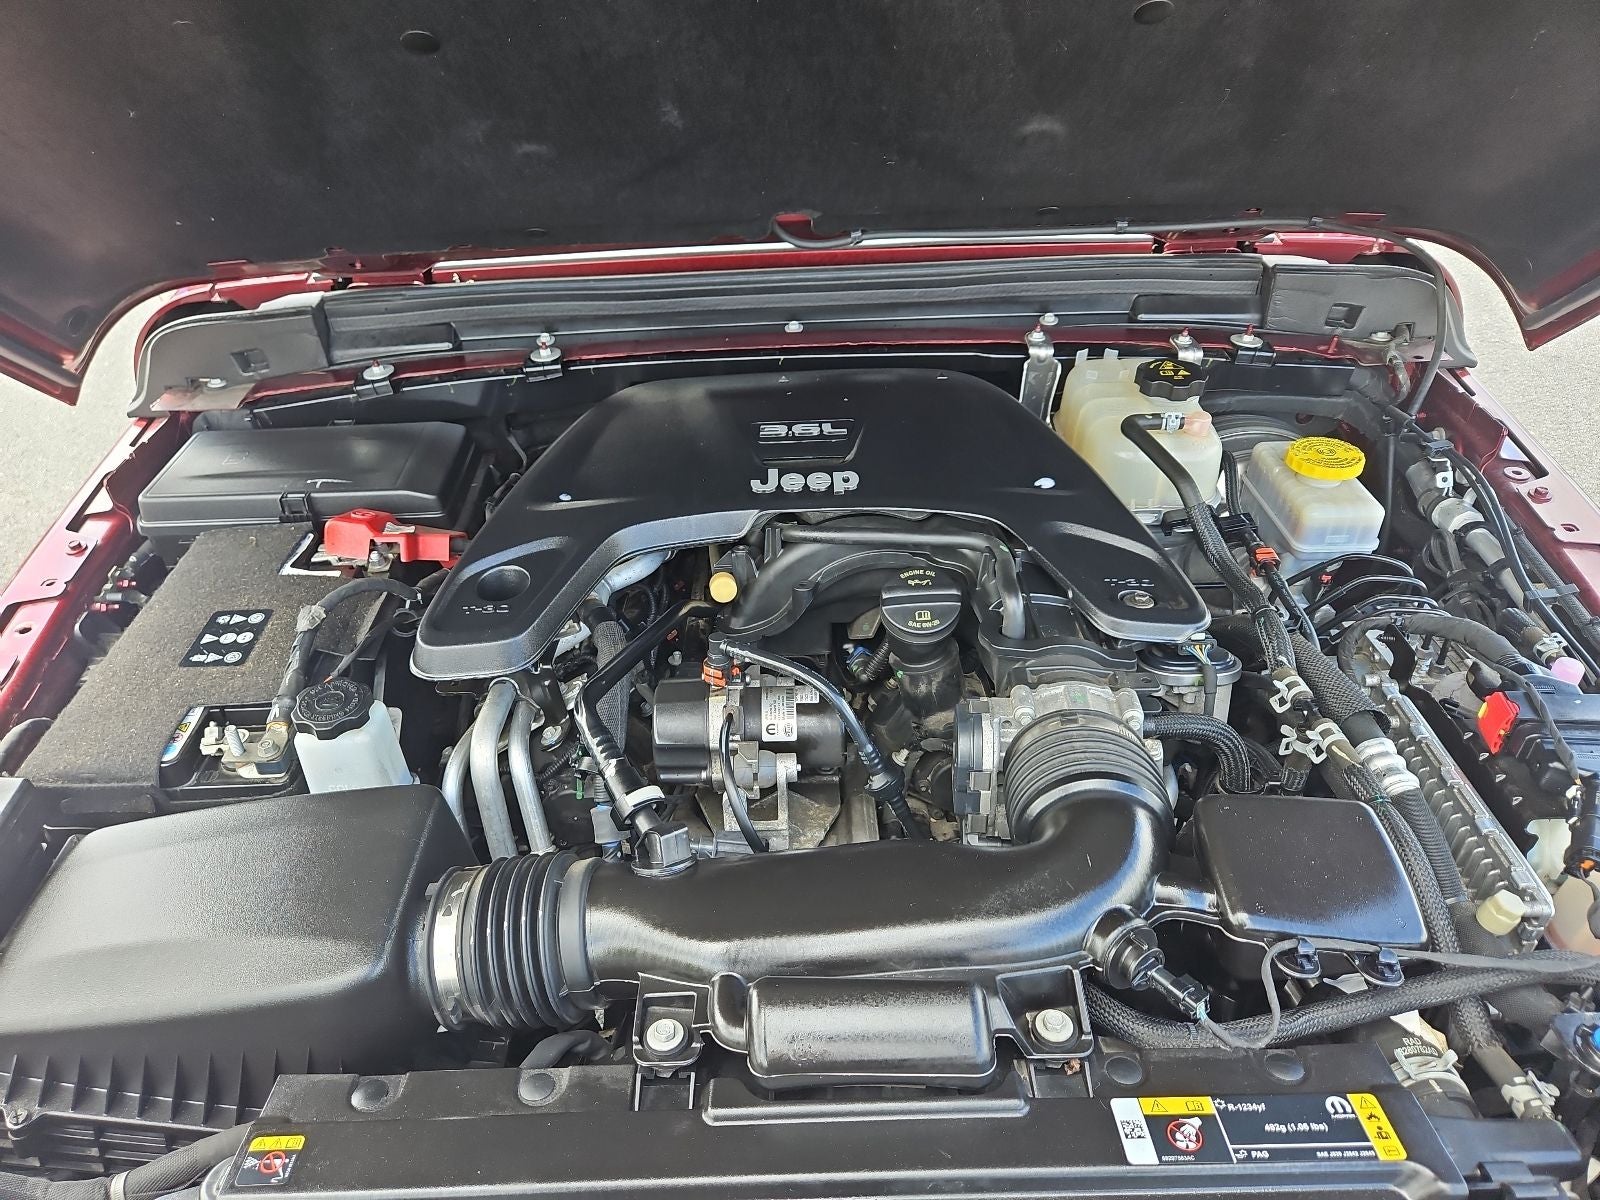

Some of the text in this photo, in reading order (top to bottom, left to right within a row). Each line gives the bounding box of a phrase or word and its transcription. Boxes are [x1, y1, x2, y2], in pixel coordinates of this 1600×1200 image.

[759, 422, 848, 438] 3.6L
[750, 468, 860, 496] Jeep
[899, 569, 937, 579] ENGINE OIL
[907, 620, 922, 628] SAE
[1402, 1037, 1422, 1046] RAD
[1227, 1102, 1266, 1114] R-1234yf
[1251, 1150, 1270, 1159] PAG
